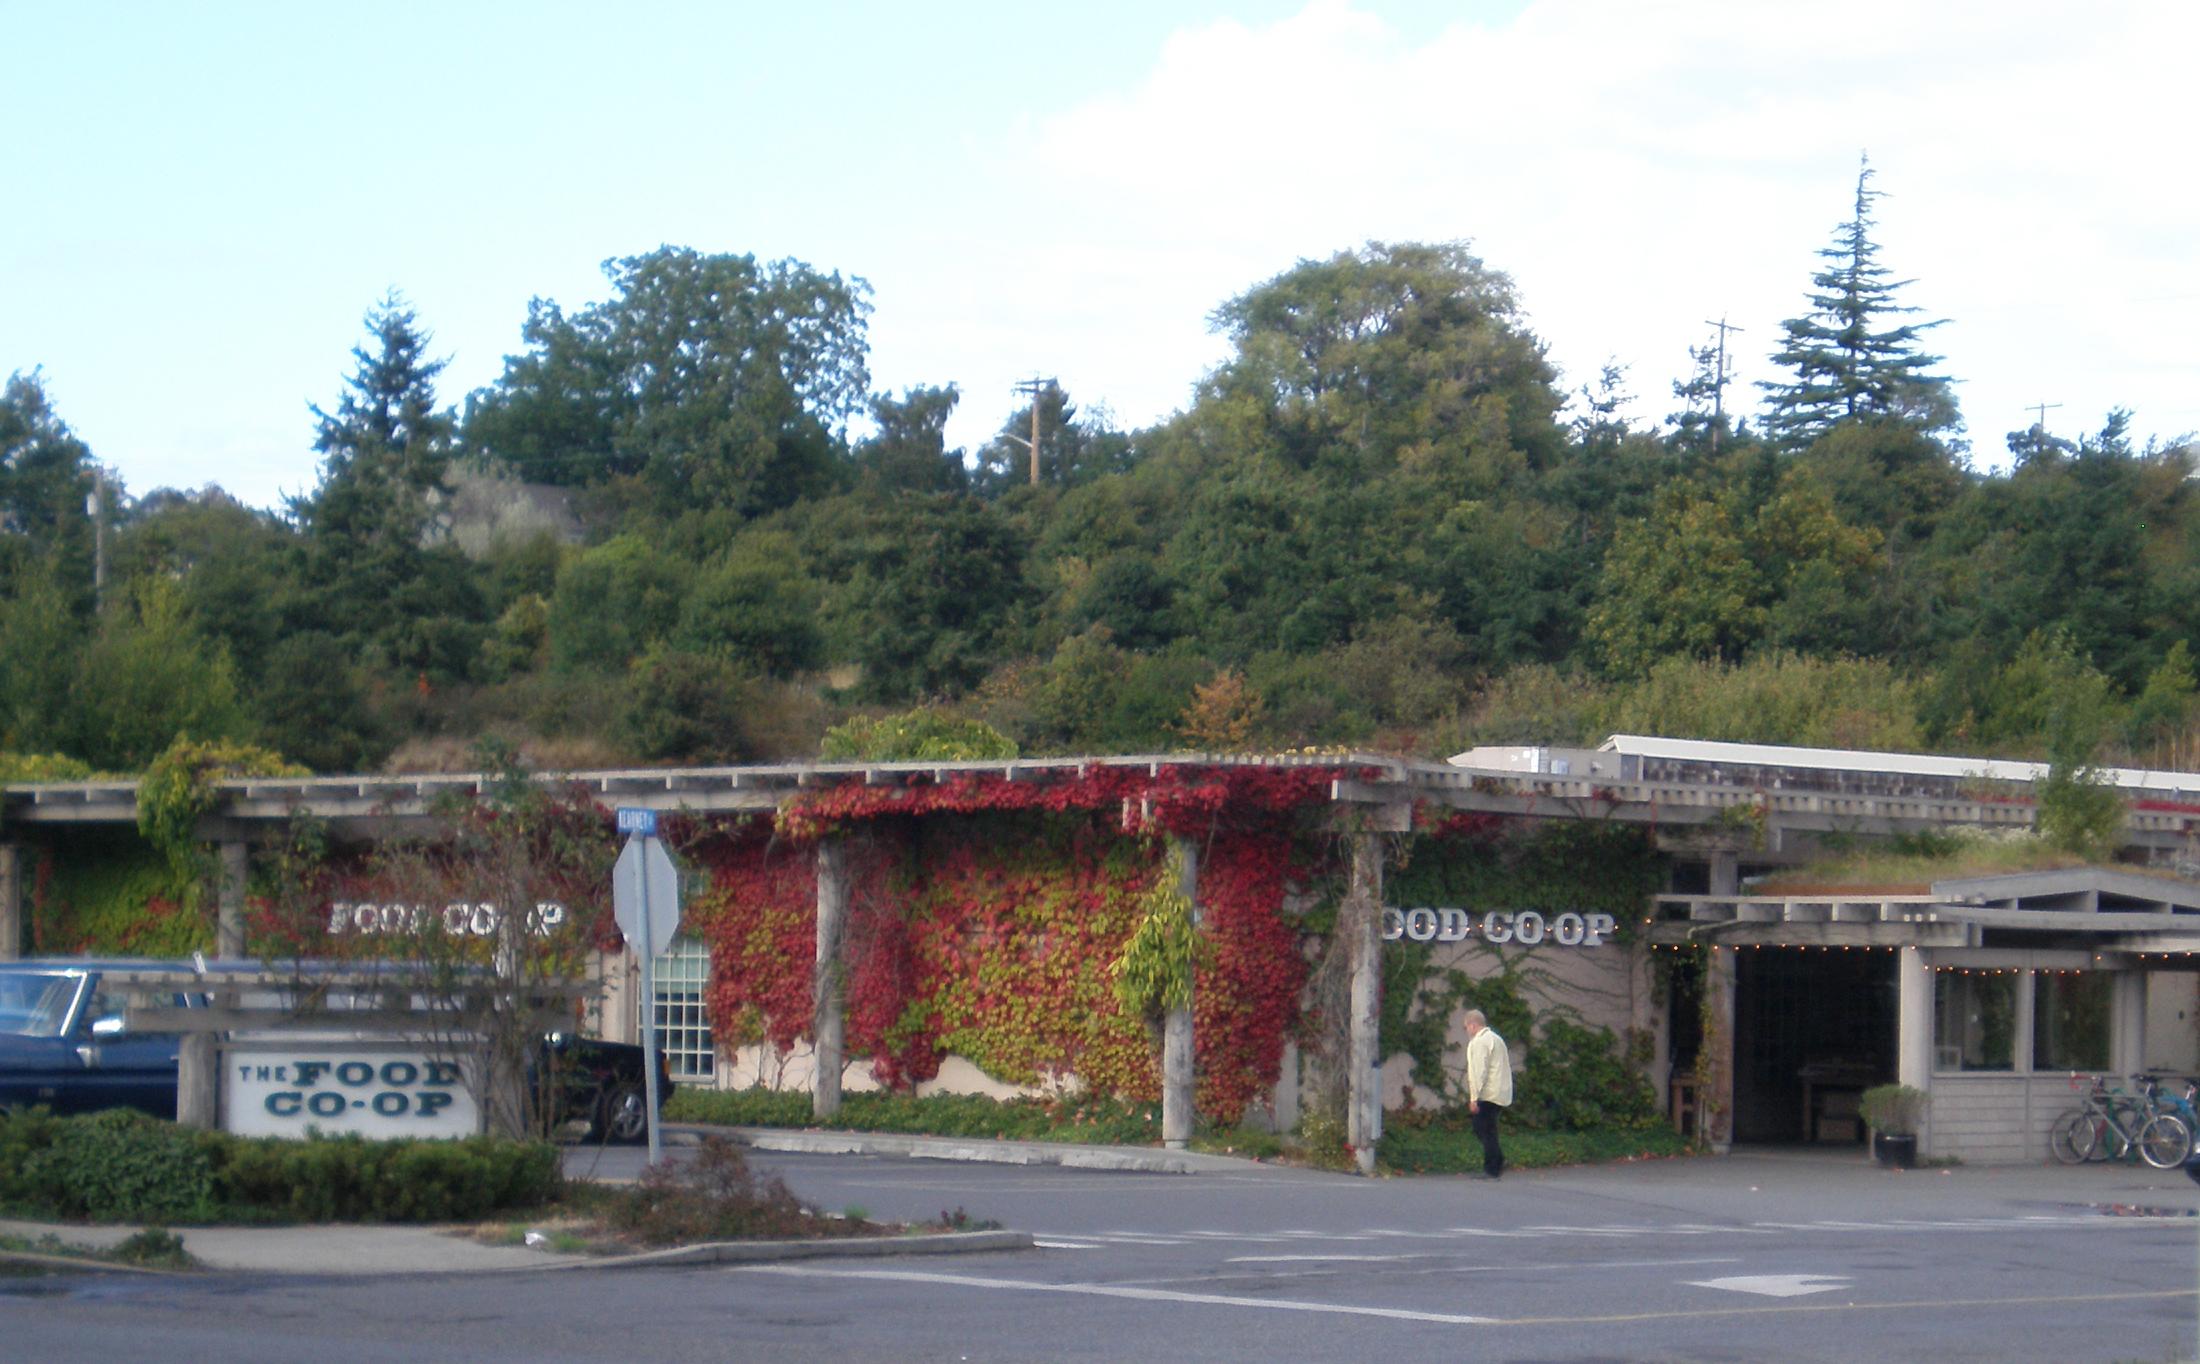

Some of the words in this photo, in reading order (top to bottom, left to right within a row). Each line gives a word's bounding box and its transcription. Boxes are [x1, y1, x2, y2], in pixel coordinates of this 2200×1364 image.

[239, 1066, 287, 1082] THE
[292, 1061, 460, 1087] FOOD
[264, 1091, 452, 1117] CO-OP
